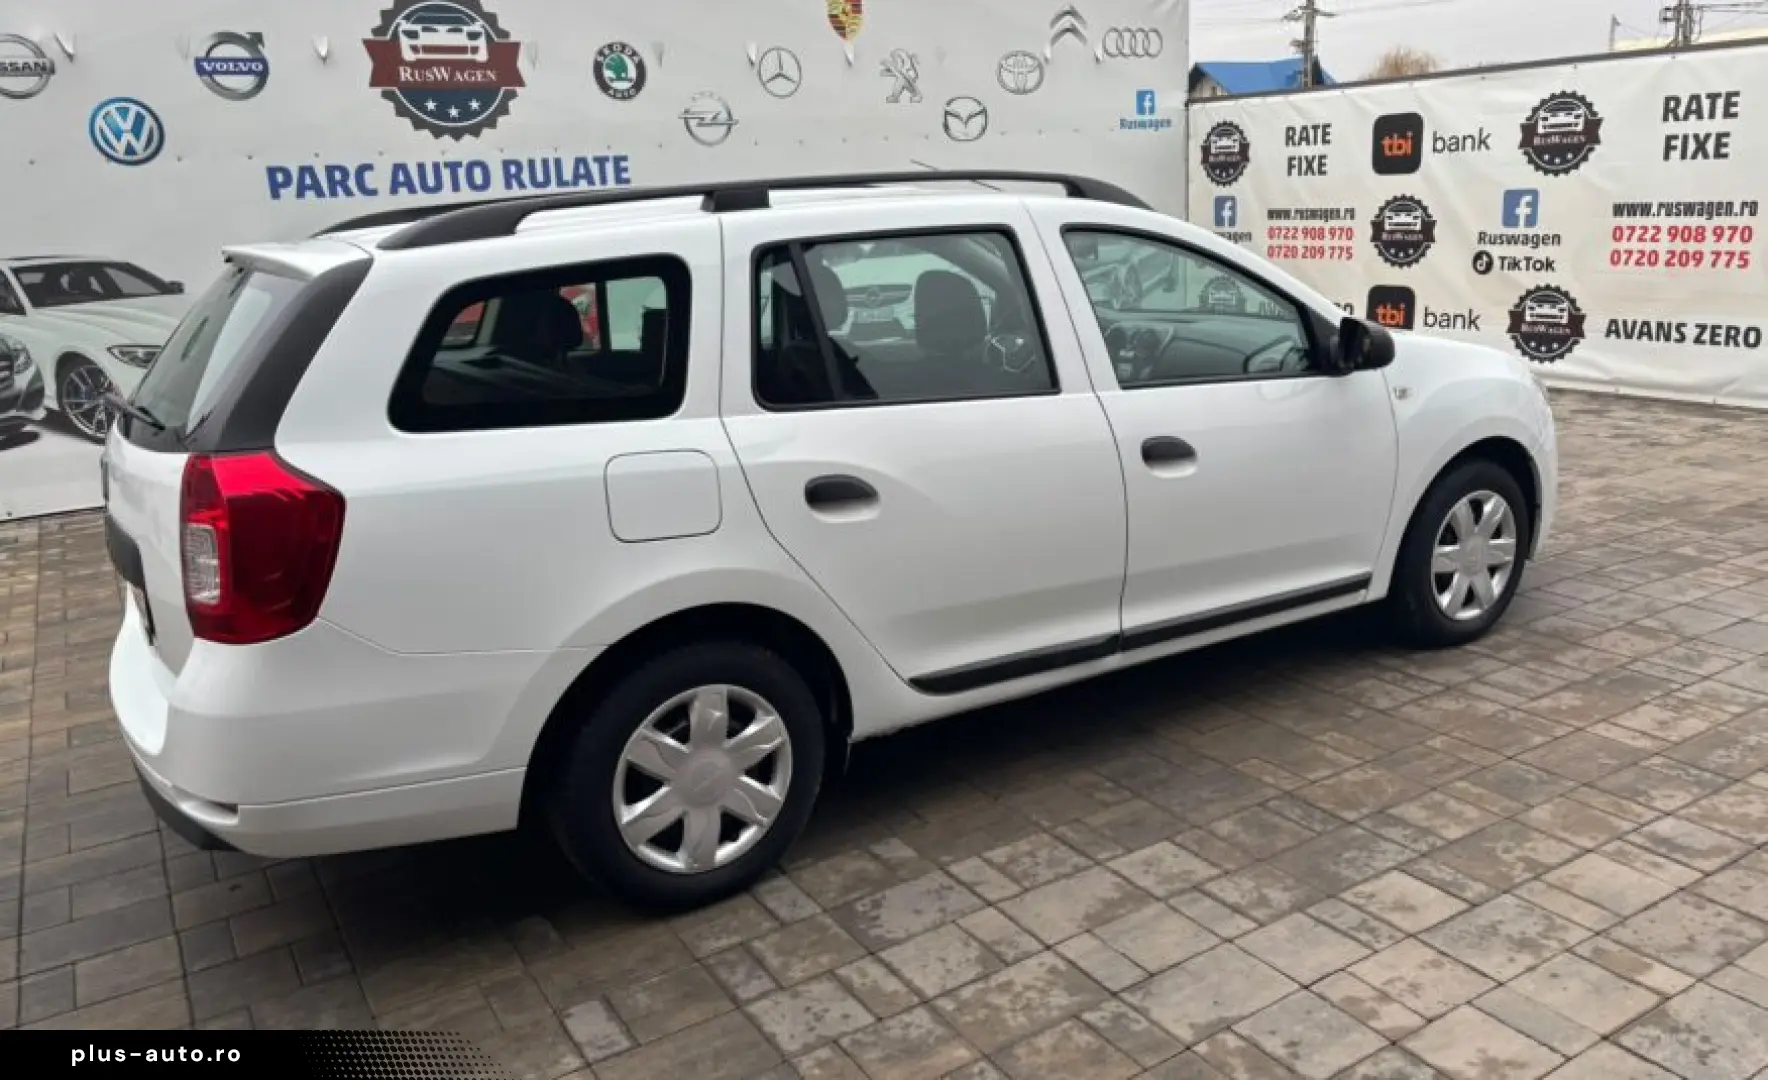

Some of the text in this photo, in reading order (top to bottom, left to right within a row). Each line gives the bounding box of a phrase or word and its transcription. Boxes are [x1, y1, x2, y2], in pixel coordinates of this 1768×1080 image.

[199, 61, 264, 73] VOLVO
[1661, 90, 1741, 123] RATE
[1284, 123, 1333, 147] RATE
[1381, 127, 1492, 157] tbi bank
[1662, 131, 1732, 162] FIXE
[1286, 155, 1329, 177] FIXE
[265, 155, 632, 200] PARC AUTO RULATE
[1611, 200, 1760, 221] www.ruswagen.ro
[1266, 226, 1355, 241] 0722 908 970
[1476, 230, 1562, 249] Ruswagen
[1611, 225, 1754, 244] 0722 908 970
[1266, 245, 1354, 260] 0720 209 775
[1609, 249, 1750, 270] 0720 209 775
[1497, 255, 1557, 273] TikTok
[1375, 302, 1407, 326] tbi
[1422, 305, 1482, 331] bank
[1603, 318, 1763, 350] AVANS ZERO
